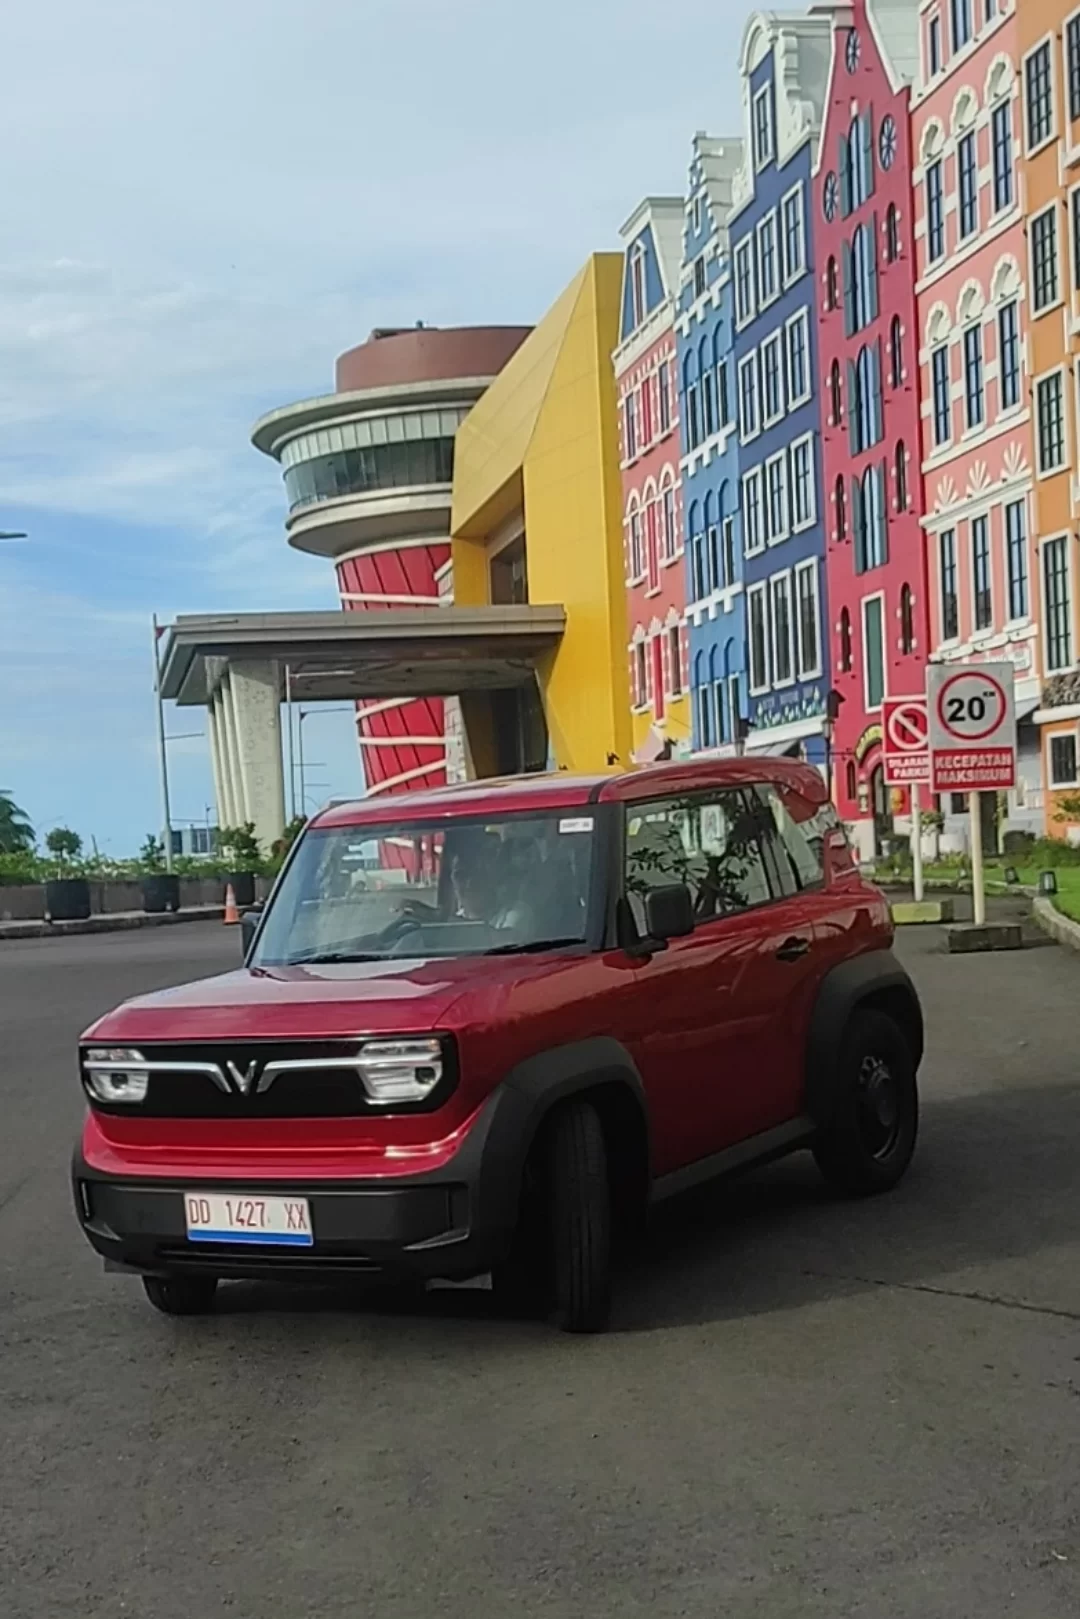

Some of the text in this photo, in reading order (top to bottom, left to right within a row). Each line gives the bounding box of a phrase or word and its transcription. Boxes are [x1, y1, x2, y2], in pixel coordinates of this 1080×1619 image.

[947, 696, 986, 722] 20
[888, 757, 929, 769] DILARAN
[935, 753, 1012, 769] KECEPATAN
[937, 768, 1011, 784] MAKSIMUM
[188, 1199, 307, 1229] DD 1427 XX
